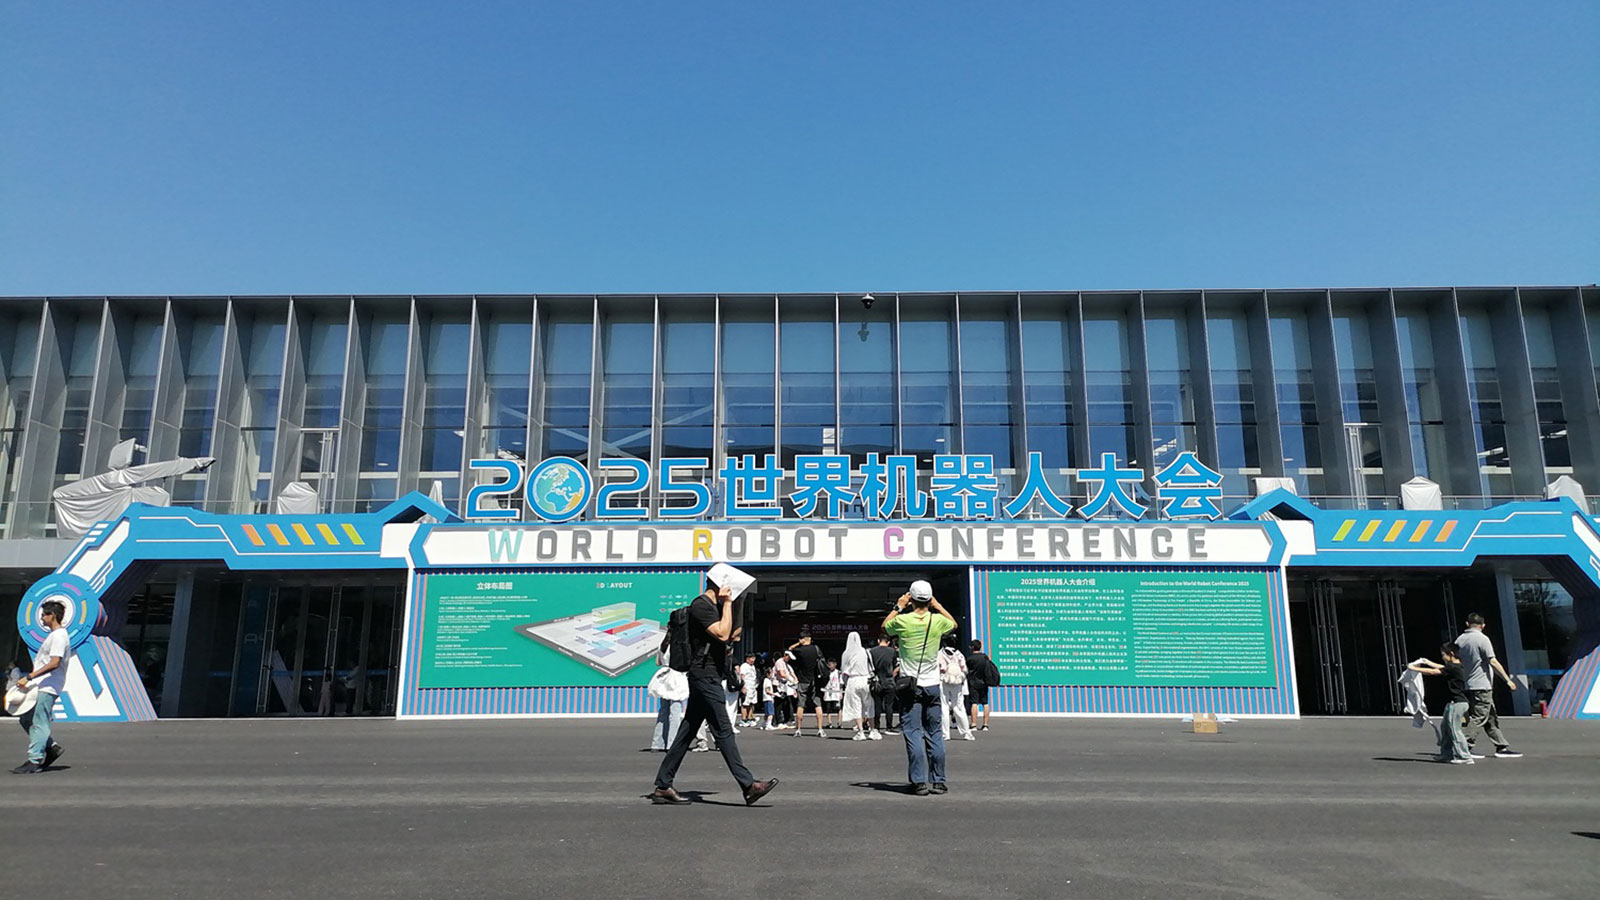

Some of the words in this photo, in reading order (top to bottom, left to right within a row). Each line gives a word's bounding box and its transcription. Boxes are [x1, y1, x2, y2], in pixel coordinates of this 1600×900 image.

[465, 451, 1224, 522] 2025世界机器人大会
[488, 528, 658, 561] WORLD
[692, 528, 848, 561] ROBOT
[883, 526, 1208, 560] CONFERENCE
[476, 581, 513, 590] 立体布局图
[1020, 578, 1096, 586] 2025世界机器人大会介绍
